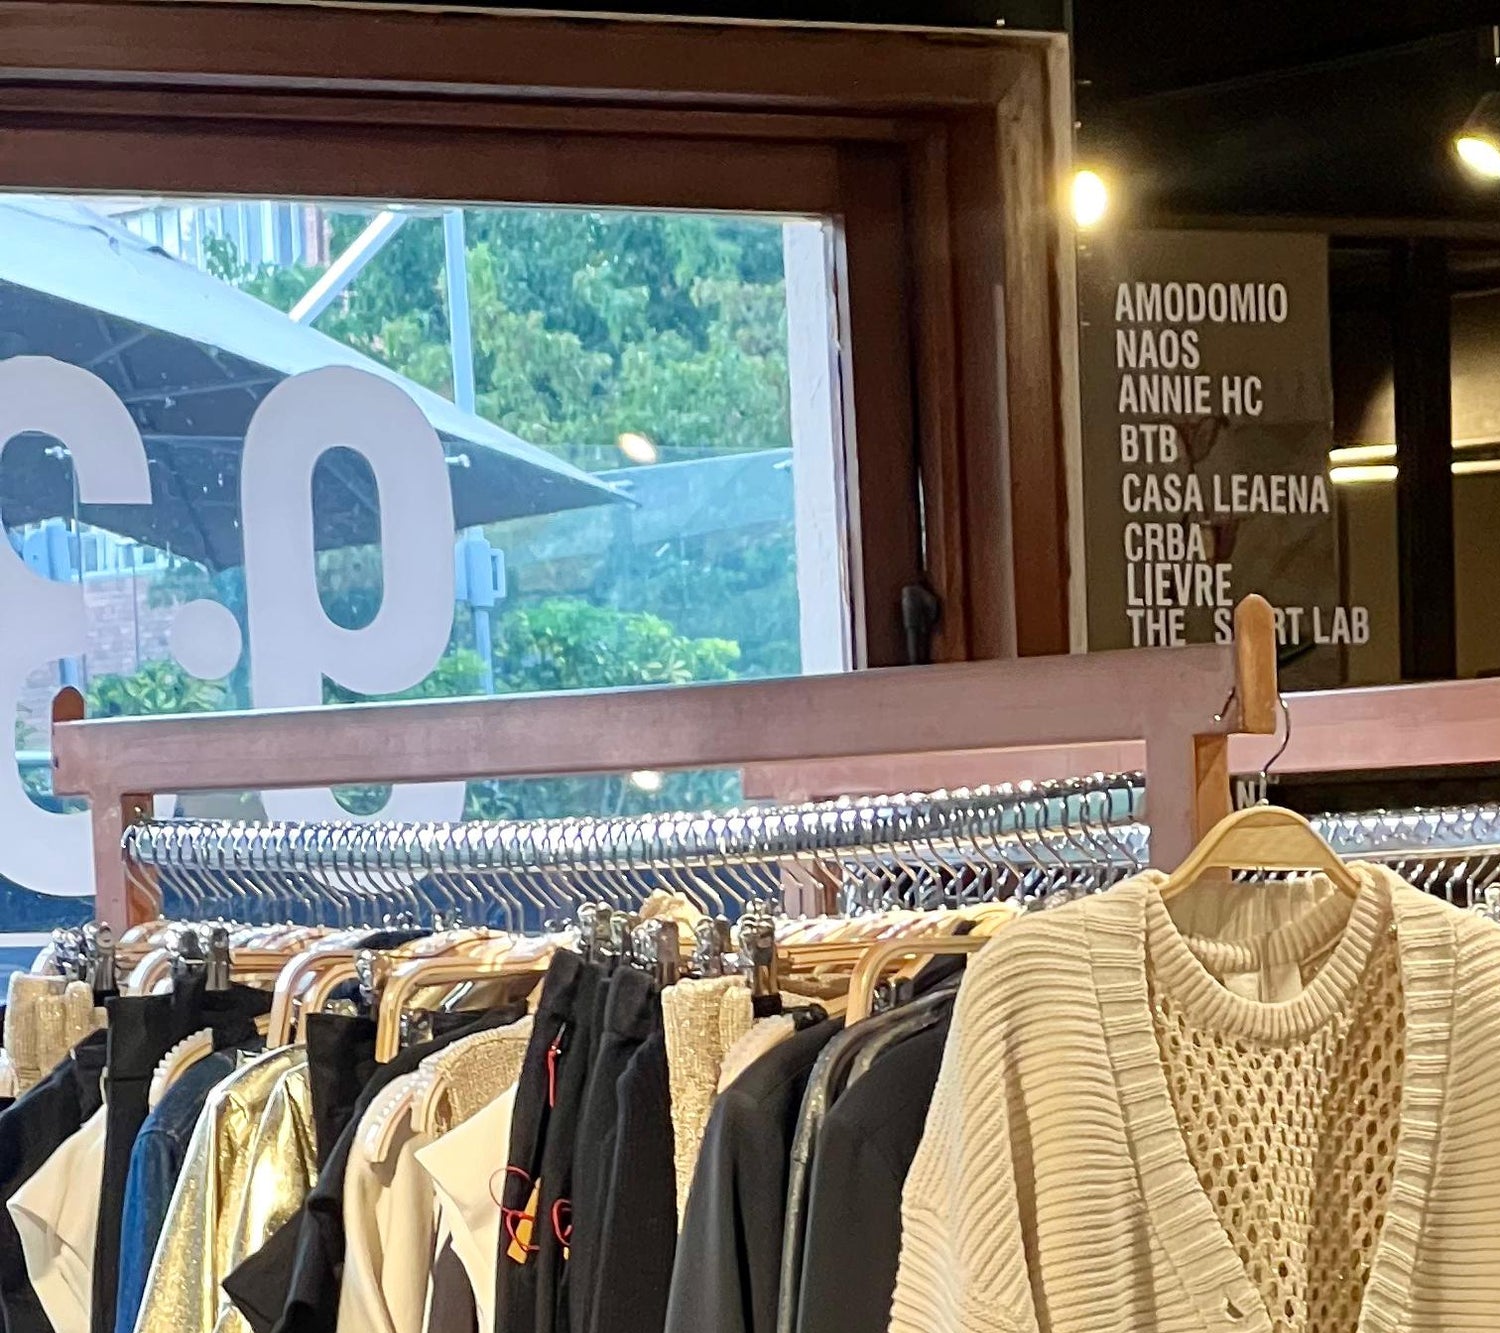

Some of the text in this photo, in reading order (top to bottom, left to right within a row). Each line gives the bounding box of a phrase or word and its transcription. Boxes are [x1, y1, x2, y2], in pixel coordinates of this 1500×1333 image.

[1115, 281, 1289, 323] AMODOMIO
[1116, 329, 1200, 370] NAOS
[1118, 374, 1263, 416] ANNIE HC
[1120, 423, 1178, 463] BTB
[1122, 473, 1331, 514] CASA LEAENA
[1124, 522, 1206, 563] CRBA
[1126, 562, 1233, 607] LIEVRE
[1126, 608, 1186, 647] THE
[1313, 606, 1370, 645] LAB
